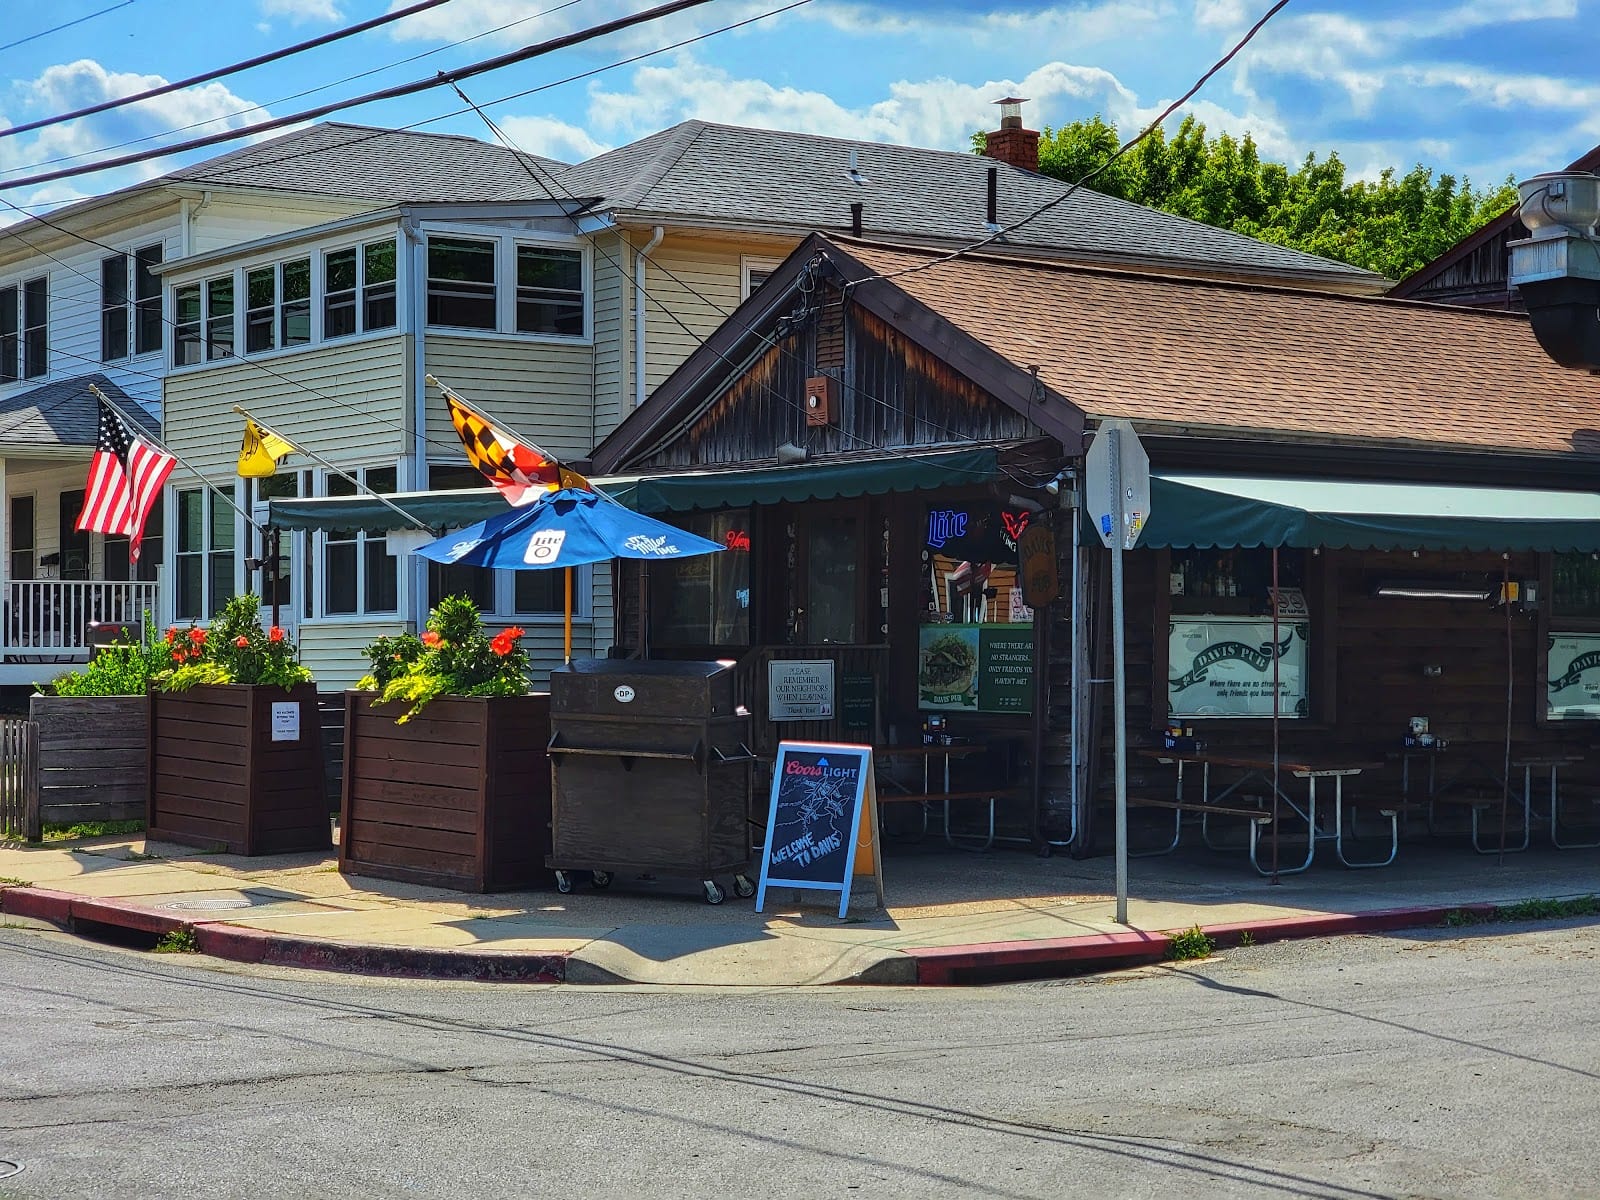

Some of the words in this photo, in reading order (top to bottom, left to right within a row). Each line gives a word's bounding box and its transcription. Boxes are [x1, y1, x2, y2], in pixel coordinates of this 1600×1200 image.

[926, 510, 968, 548] Lite
[534, 537, 562, 546] Lite
[624, 535, 666, 555] Miller
[653, 545, 682, 556] TIME
[1008, 642, 1024, 650] THERE
[1197, 644, 1239, 667] DAVIS'
[1240, 647, 1267, 668] PUB
[988, 665, 1002, 673] ONLY
[1002, 665, 1024, 673] FRIENDS
[783, 676, 820, 684] REMEMBER
[775, 685, 790, 693] OUR
[791, 684, 828, 693] NEIGHBORS
[799, 693, 827, 701] LEAVING
[950, 694, 962, 702] PUB
[1216, 689, 1228, 698] only
[1229, 689, 1248, 697] friends
[786, 760, 823, 777] Coors
[823, 767, 857, 779] LIGHT
[771, 831, 815, 864] WELCOME
[793, 851, 811, 868] TO
